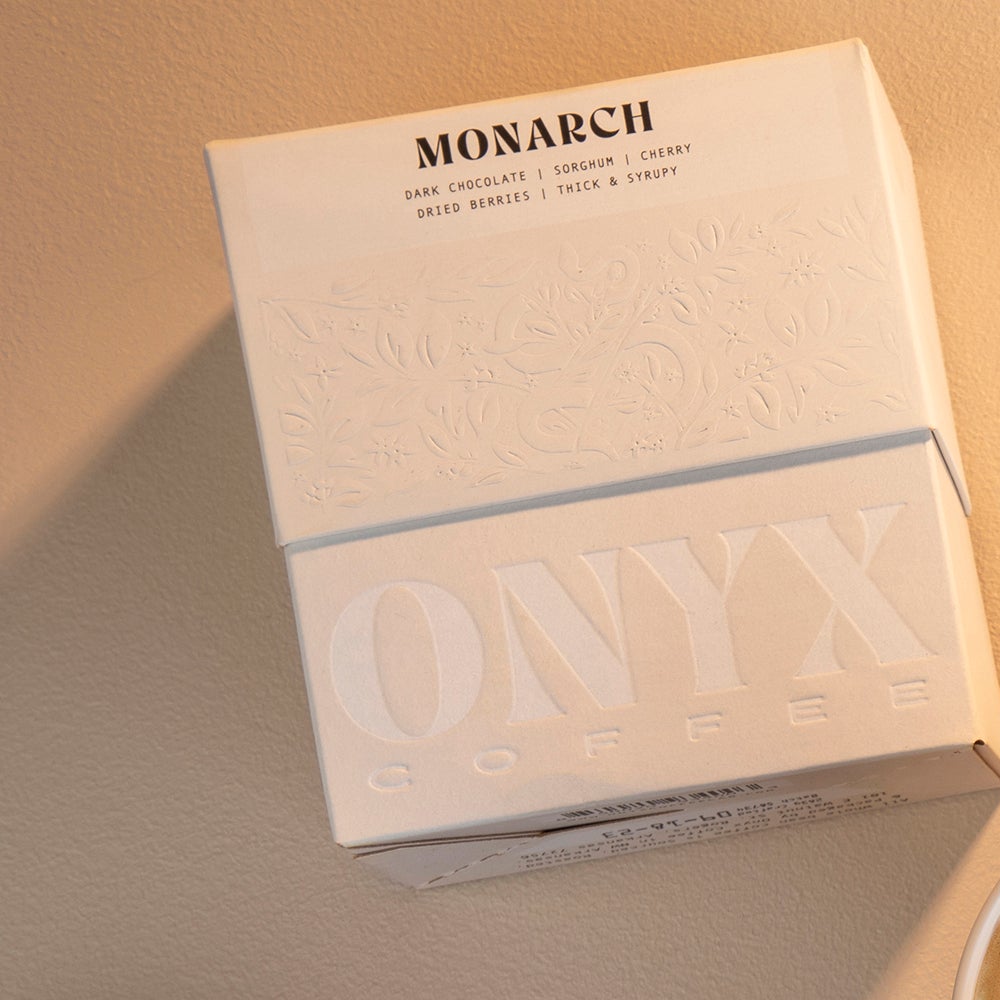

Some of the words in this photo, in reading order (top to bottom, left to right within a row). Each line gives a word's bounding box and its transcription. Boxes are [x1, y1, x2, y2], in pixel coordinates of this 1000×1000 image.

[415, 100, 654, 169] MONARCH
[405, 185, 440, 201] DARK
[448, 171, 527, 193] CHOCOLATE
[553, 156, 615, 176] SORGHUM
[640, 143, 692, 162] CHERRY
[417, 202, 460, 219] DRIED
[470, 190, 531, 210] BERRIES
[557, 178, 601, 195] THICK
[609, 176, 618, 187] &
[627, 165, 678, 184] SYRUPY
[329, 502, 940, 742] ONYX
[368, 679, 931, 792] COFFEE
